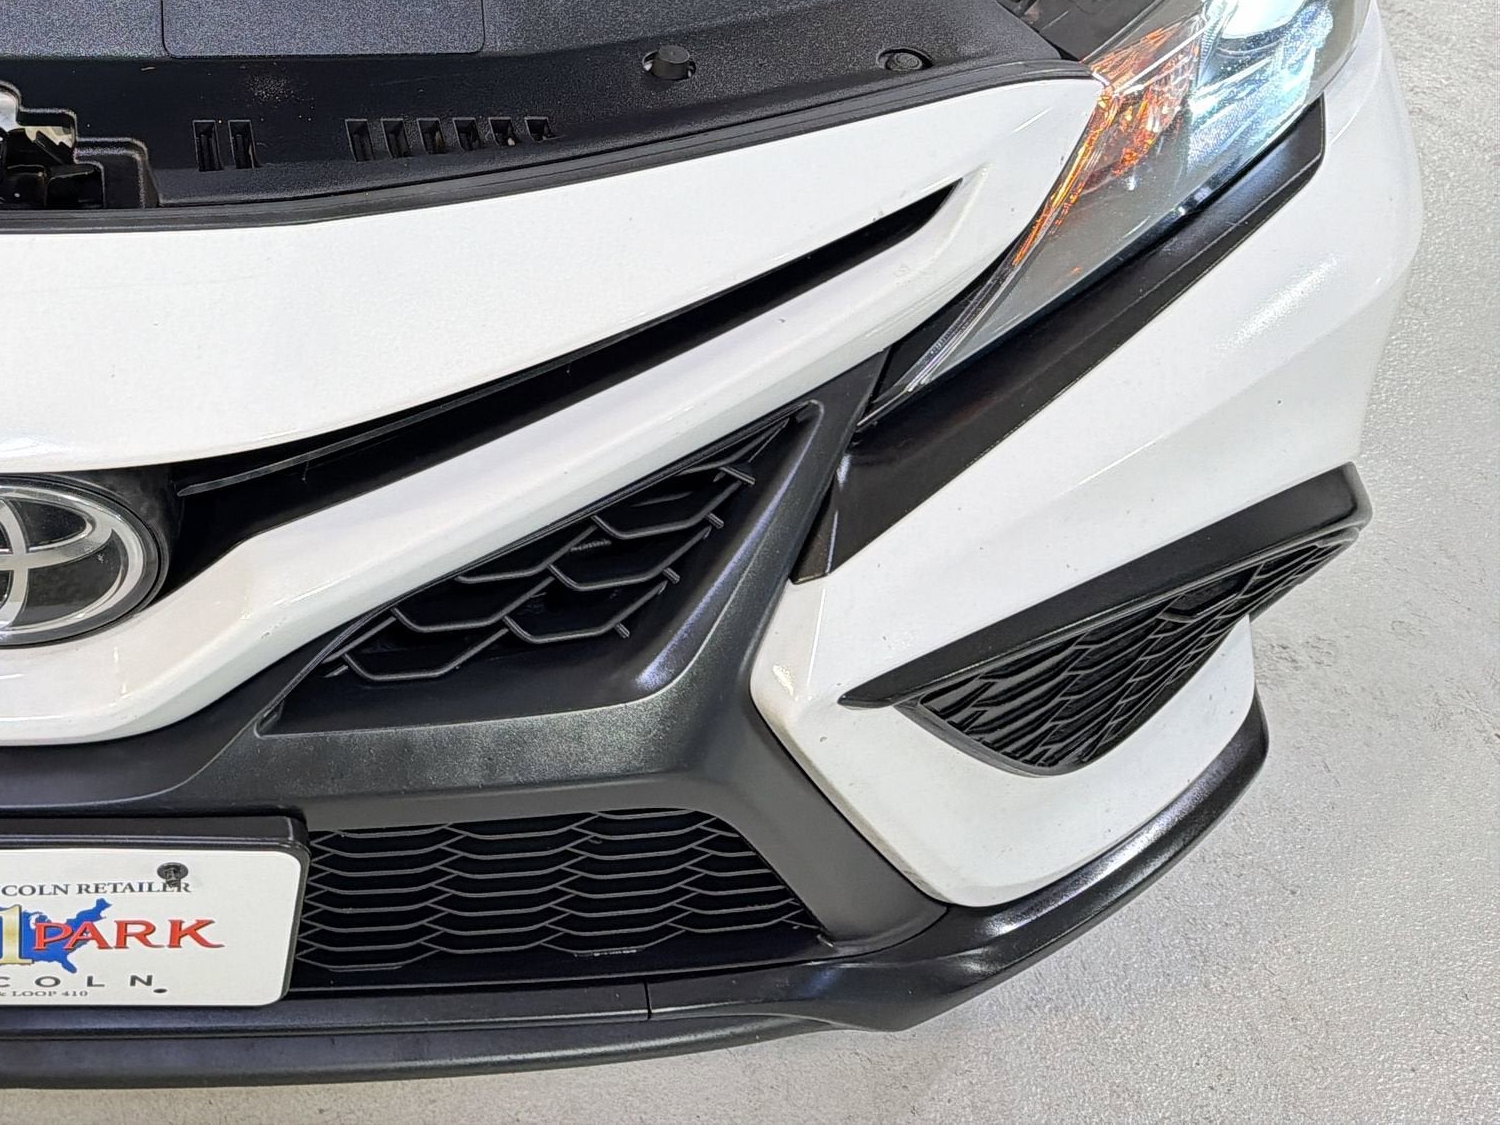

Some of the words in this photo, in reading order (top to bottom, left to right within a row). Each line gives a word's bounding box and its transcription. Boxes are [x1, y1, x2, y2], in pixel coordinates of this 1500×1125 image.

[76, 881, 192, 895] RETAILER
[33, 918, 226, 950] PARK
[11, 990, 58, 998] LOOP
[60, 990, 89, 998] 410
